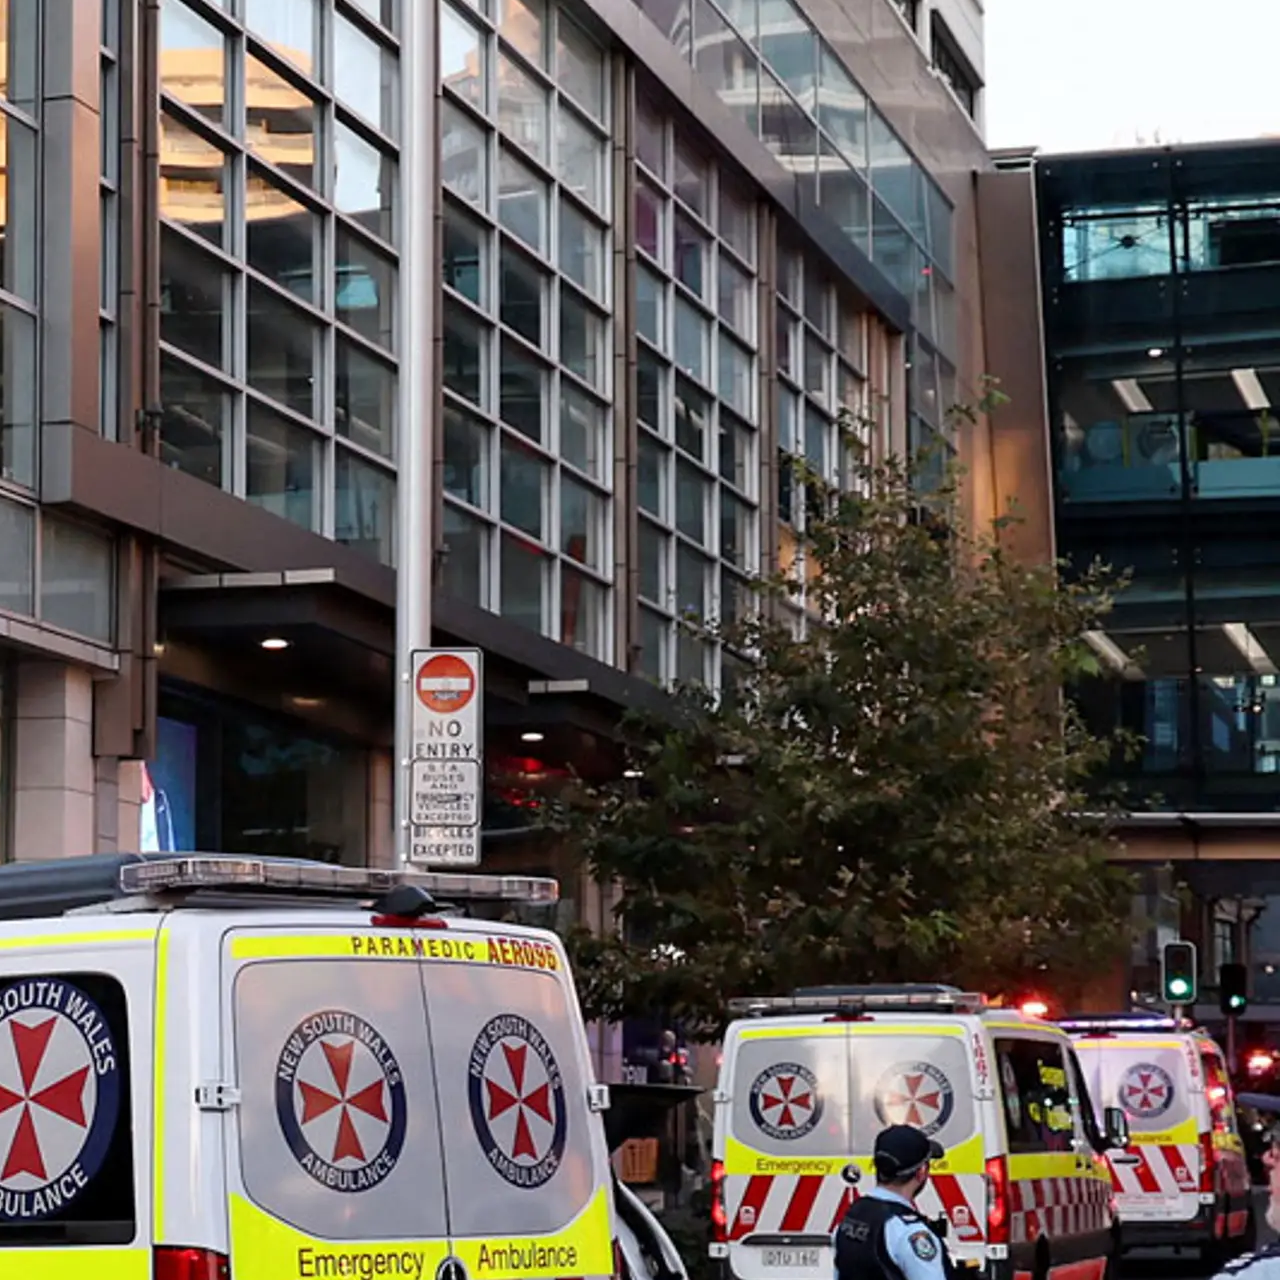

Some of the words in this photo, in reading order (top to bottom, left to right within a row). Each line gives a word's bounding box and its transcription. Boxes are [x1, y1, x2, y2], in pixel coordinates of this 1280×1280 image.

[428, 720, 463, 737] NO
[415, 742, 475, 757] ENTRY
[413, 842, 475, 858] EXCEPTED
[350, 935, 475, 960] PARAMEDIC
[63, 990, 116, 1076] WALES
[278, 1037, 306, 1083] NEW
[302, 1012, 356, 1041] SOUTH
[356, 1020, 400, 1088] WALES
[300, 1150, 395, 1190] AMBULANCE
[477, 1243, 578, 1271] Ambulance
